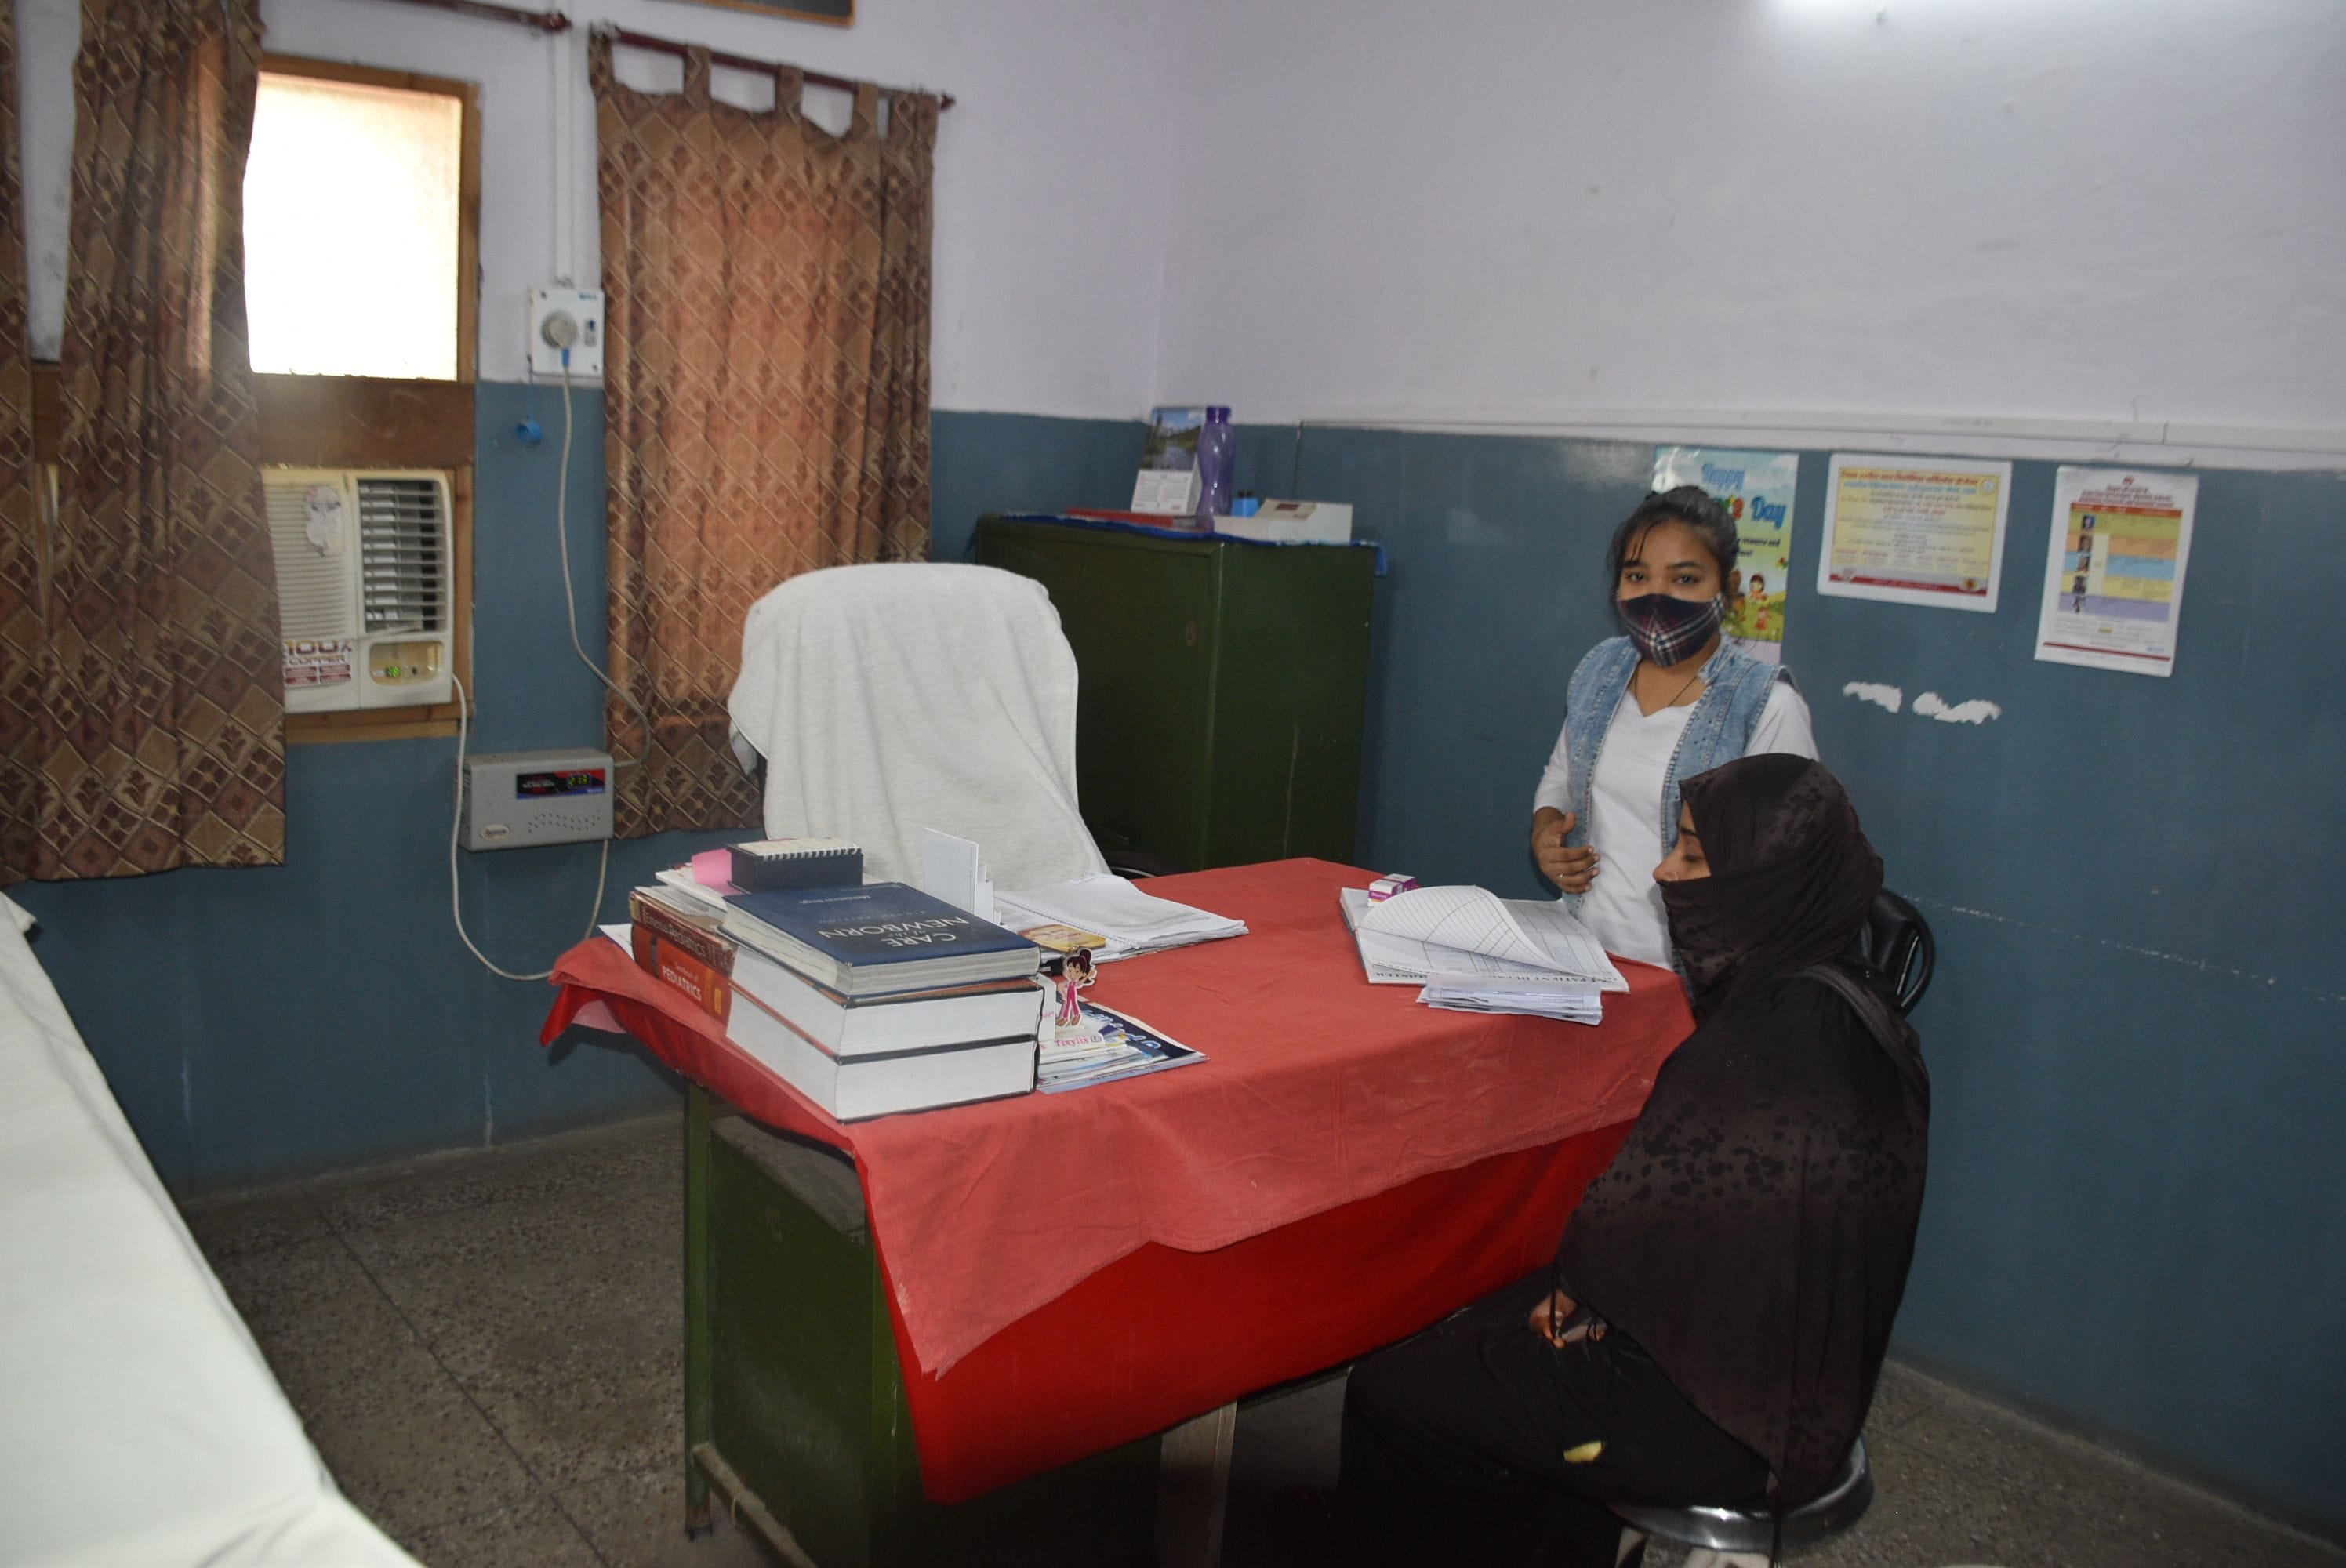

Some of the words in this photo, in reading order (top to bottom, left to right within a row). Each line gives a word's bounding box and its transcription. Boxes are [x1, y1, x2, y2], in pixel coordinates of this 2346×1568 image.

[1701, 463, 1745, 492] Happy
[1751, 495, 1788, 530] Day
[818, 916, 971, 938] NEWBORN
[881, 933, 957, 947] CARE
[661, 964, 703, 1002] PEDIATRICS
[1054, 1035, 1091, 1047] Tixylix
